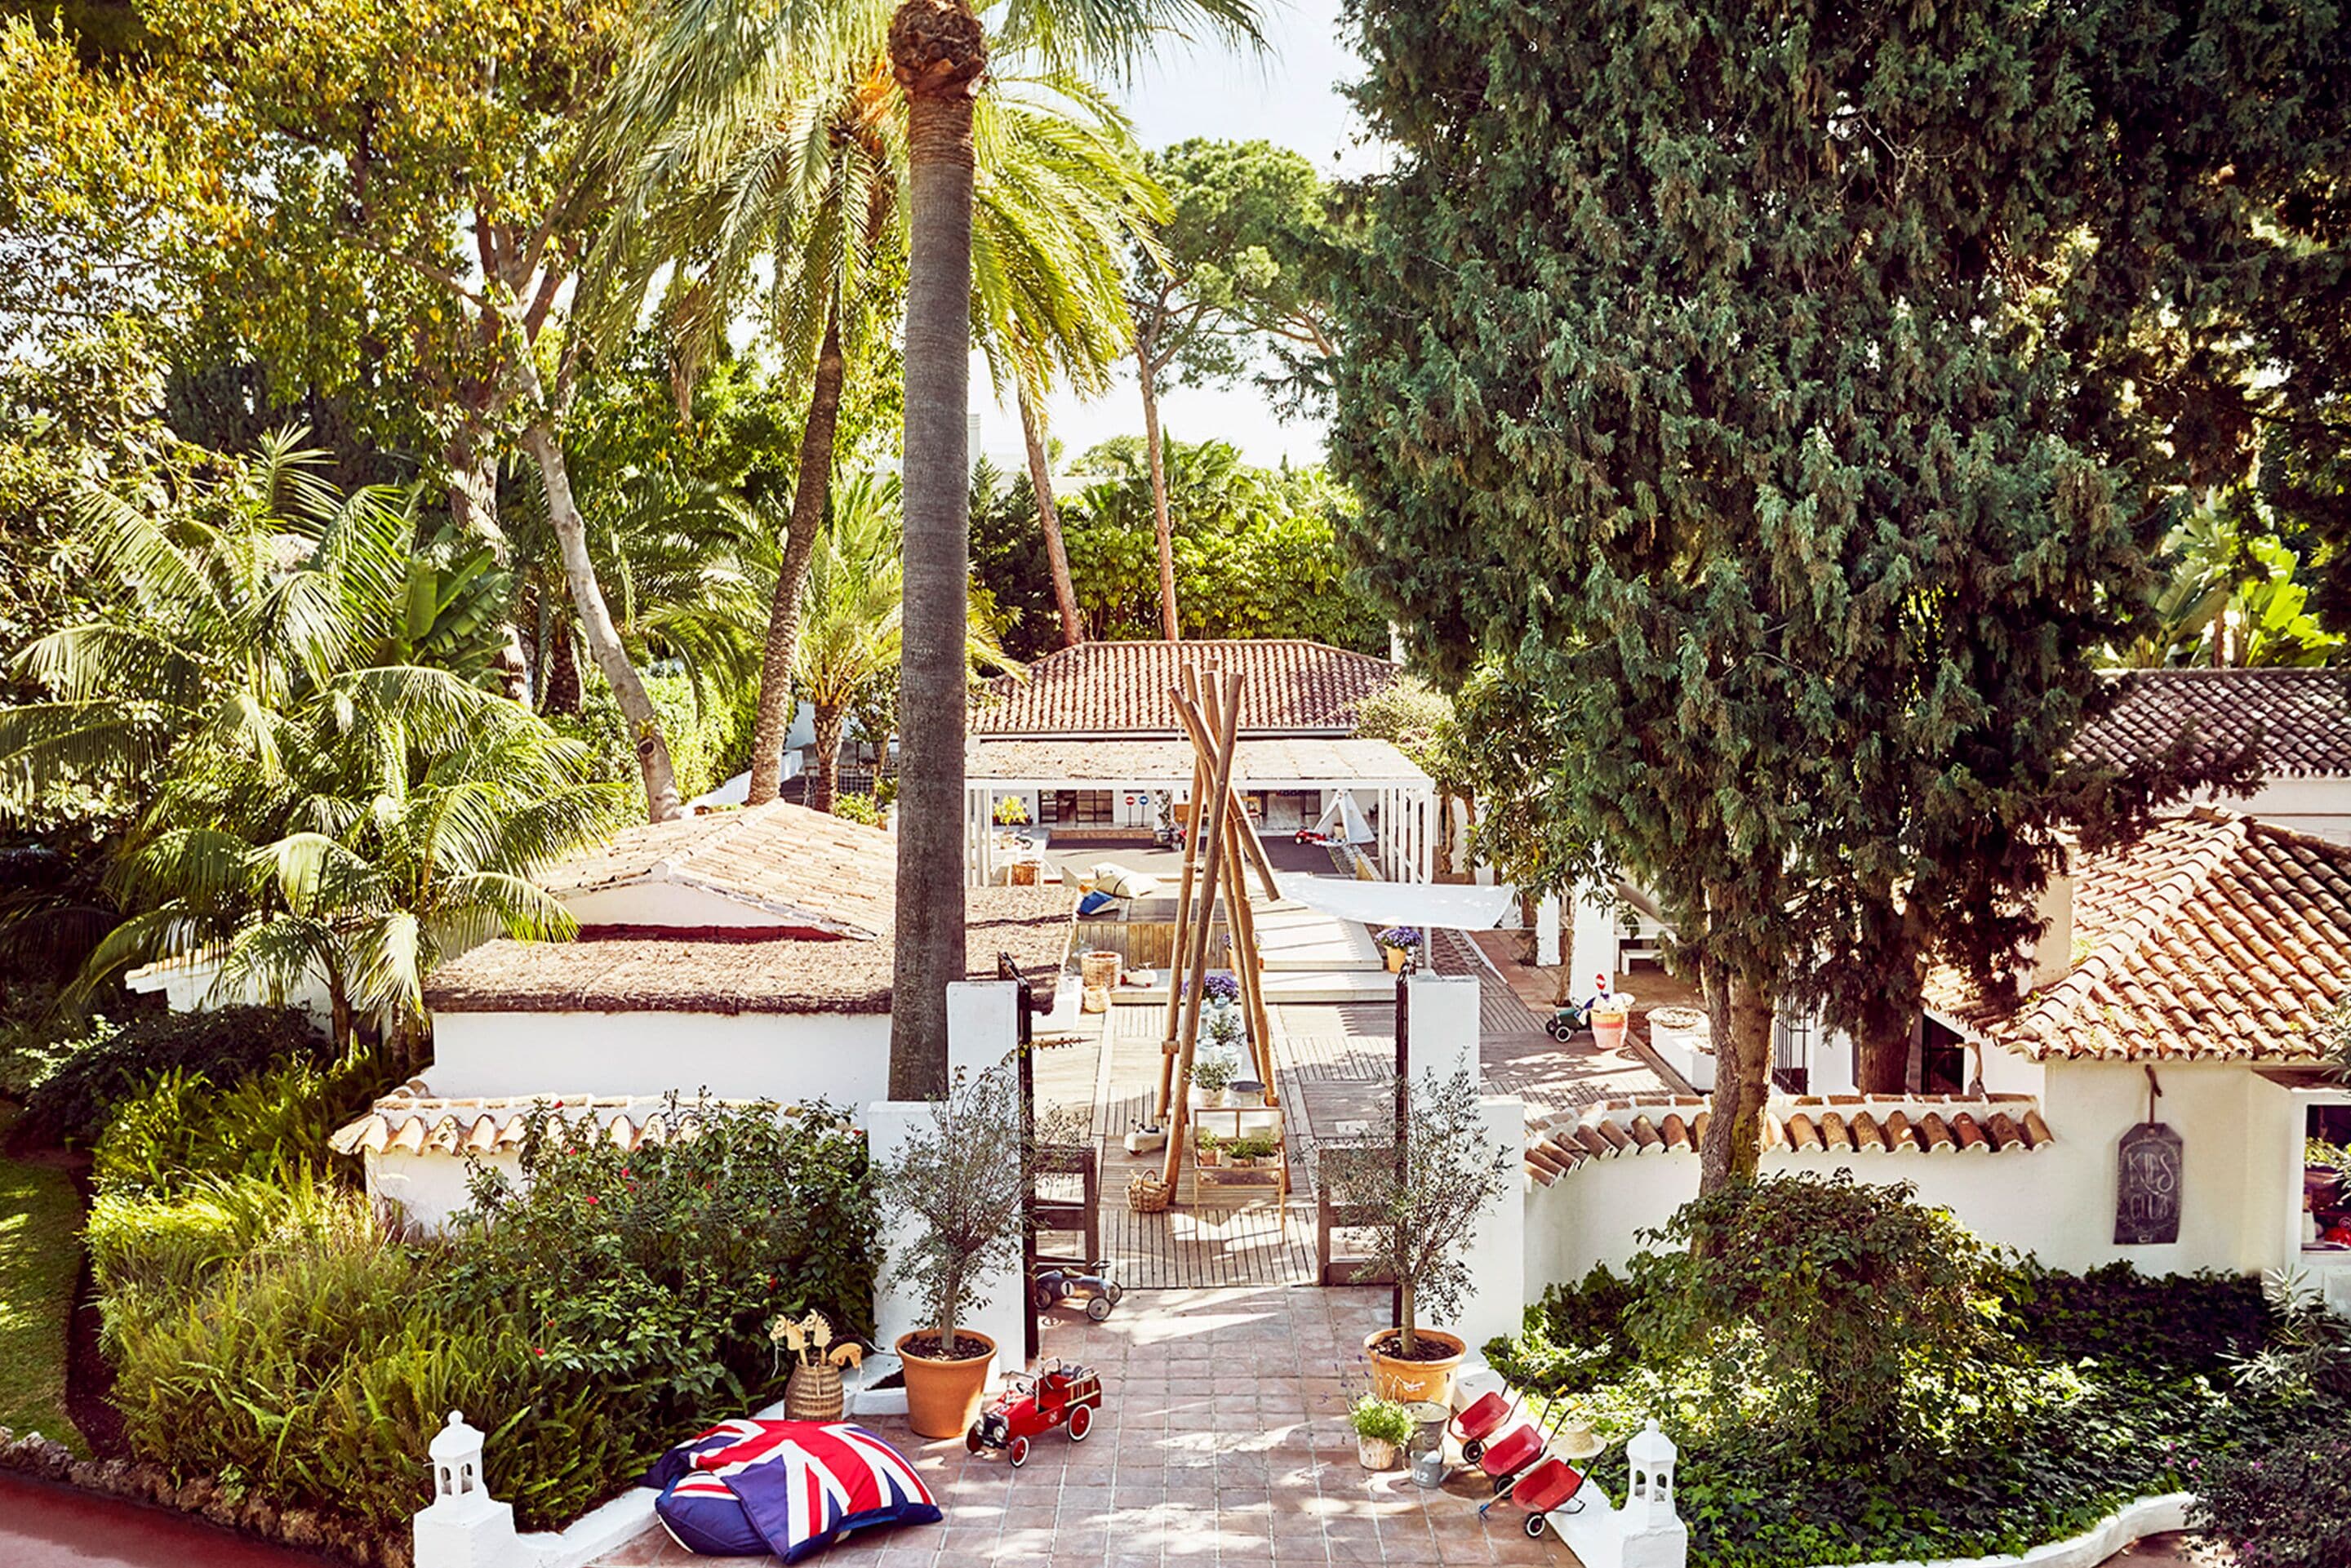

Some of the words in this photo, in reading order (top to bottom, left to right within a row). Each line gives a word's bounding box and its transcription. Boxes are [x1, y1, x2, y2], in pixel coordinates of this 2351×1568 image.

[2127, 1152, 2174, 1195] KIDS
[2130, 1194, 2168, 1219] CLUB
[1065, 1282, 1070, 1295] 1
